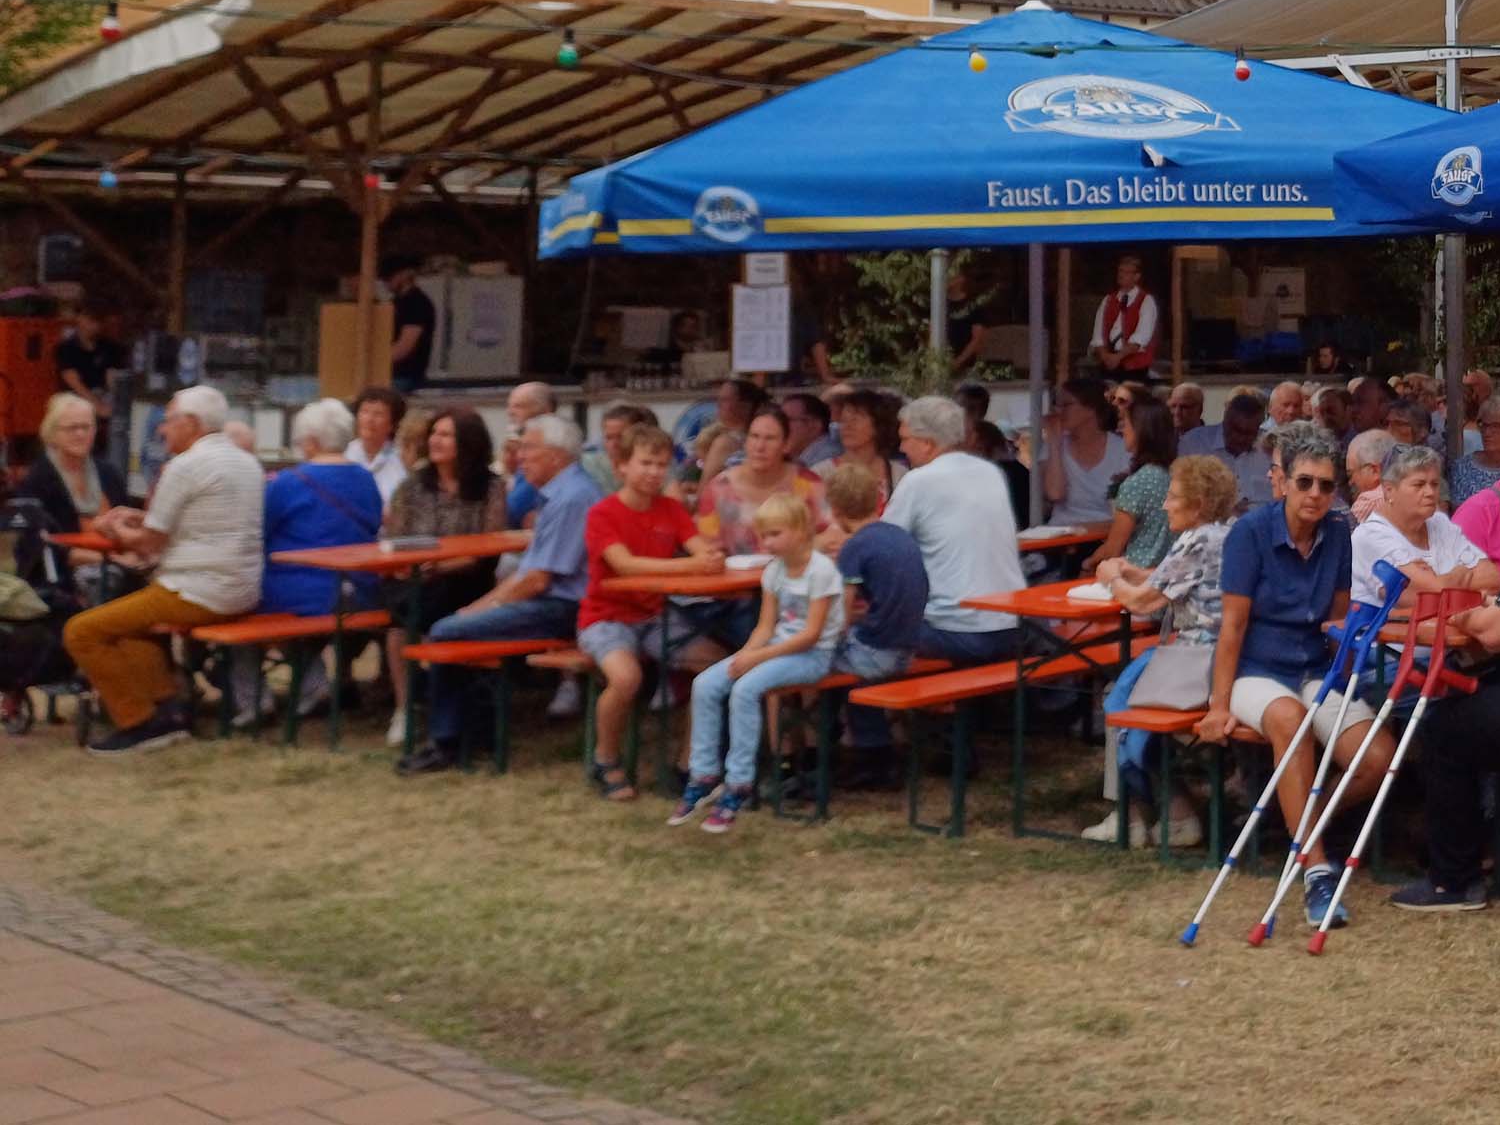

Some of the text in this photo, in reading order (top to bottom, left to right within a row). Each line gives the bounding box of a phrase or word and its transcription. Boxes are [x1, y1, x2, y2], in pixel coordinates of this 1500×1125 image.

[986, 176, 1308, 207] Faust. Das bleibt unter uns.
